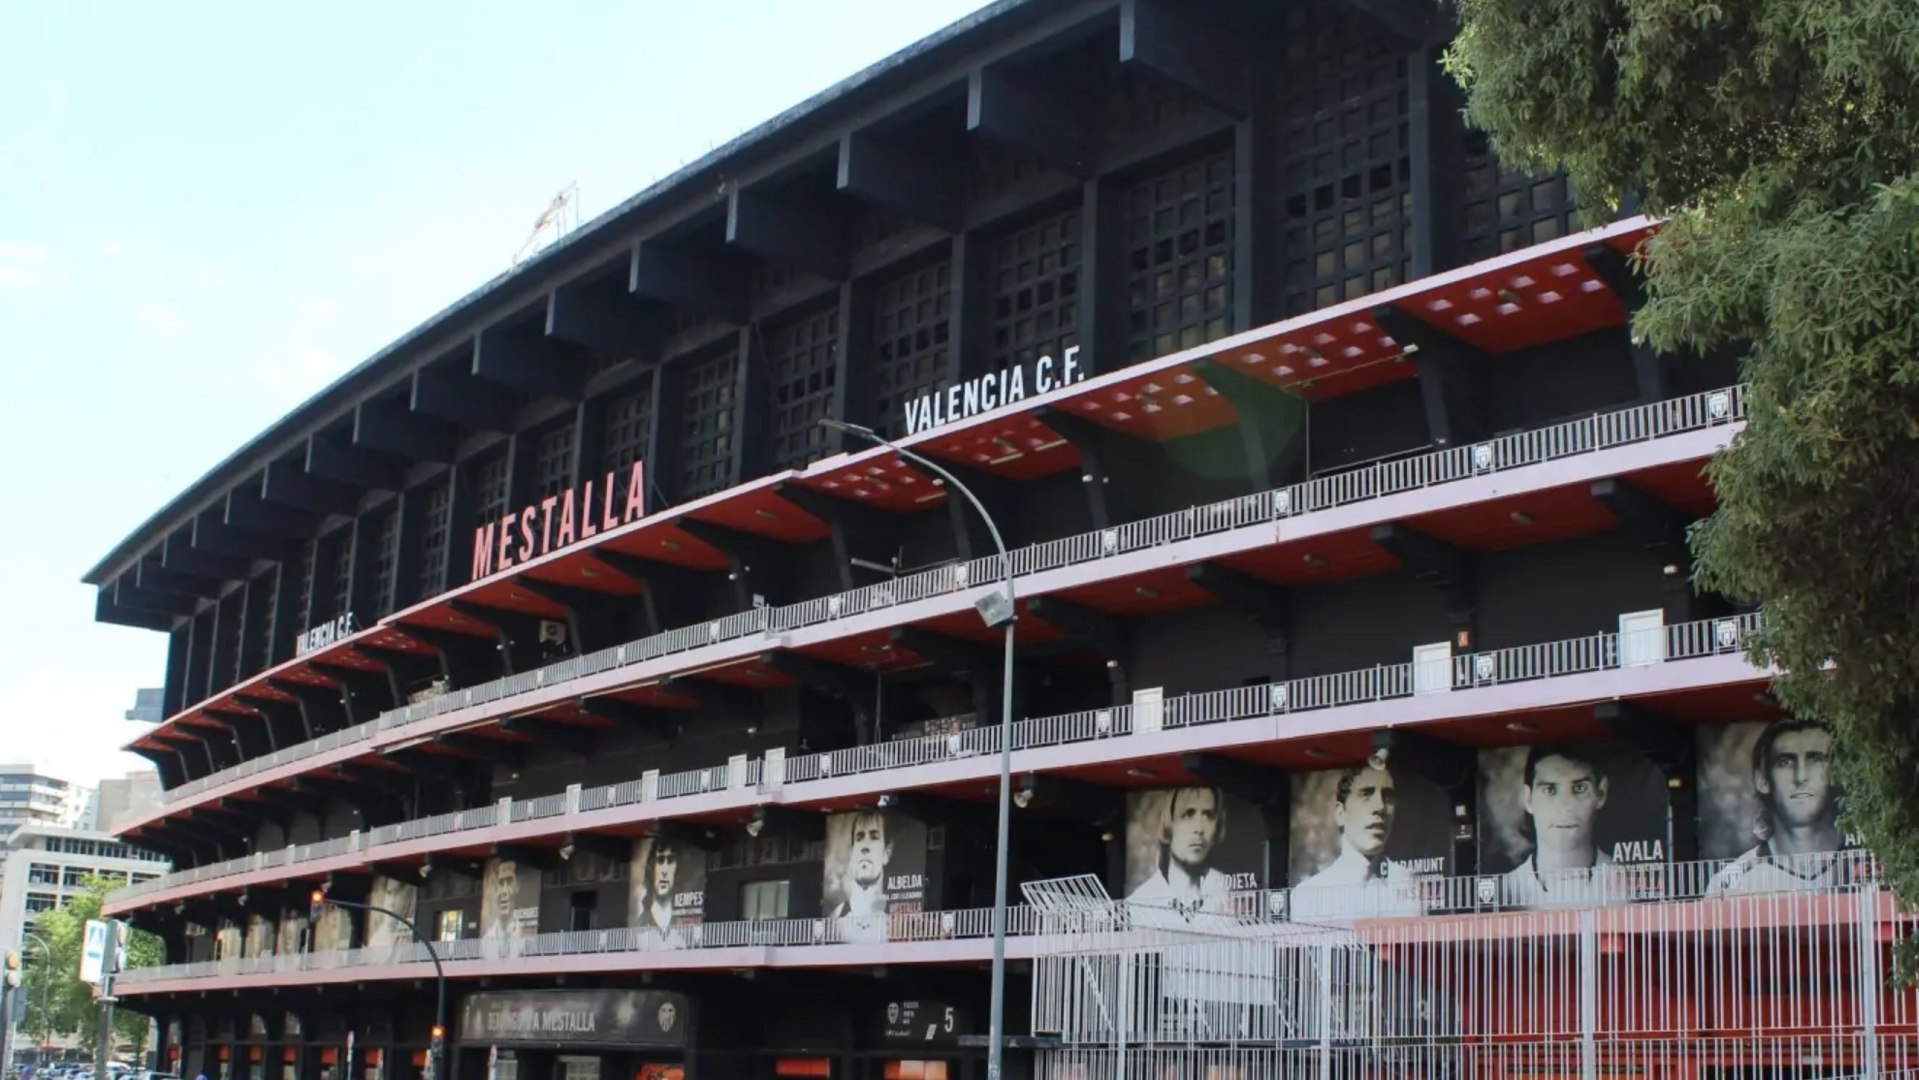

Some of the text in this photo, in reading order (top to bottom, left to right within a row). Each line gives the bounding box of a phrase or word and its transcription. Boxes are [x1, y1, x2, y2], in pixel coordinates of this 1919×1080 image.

[905, 345, 1085, 435] VALENCIA C.F.
[472, 460, 645, 582] MESTALLA
[1612, 839, 1664, 862] AYALA
[1380, 856, 1445, 876] CRAMUNT
[887, 874, 923, 890] ALBELDA
[1200, 872, 1258, 891] MNDIETA
[674, 891, 704, 907] KEMPES
[542, 1010, 596, 1032] MESTALLA
[944, 1007, 954, 1032] 5
